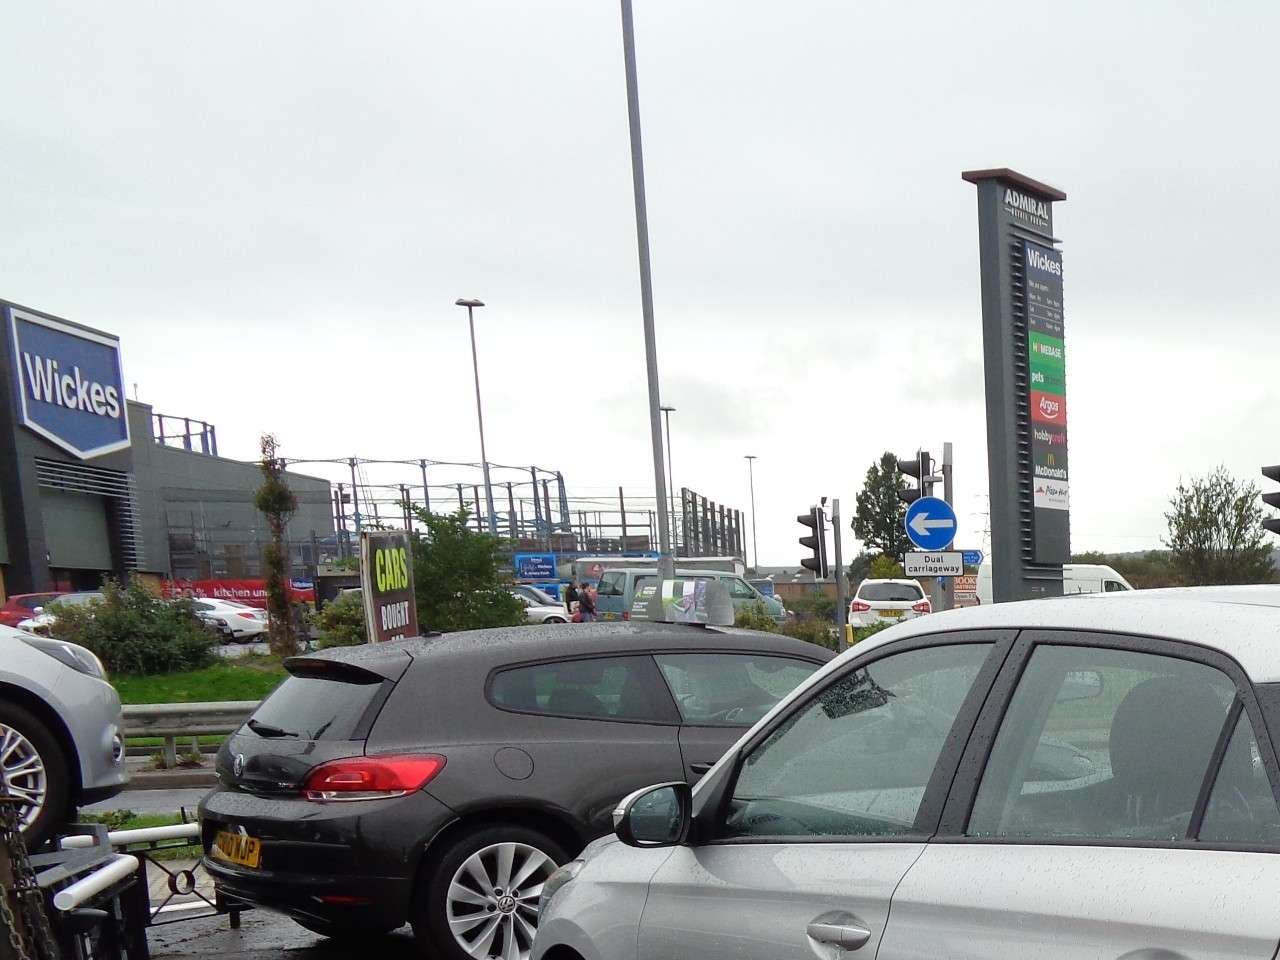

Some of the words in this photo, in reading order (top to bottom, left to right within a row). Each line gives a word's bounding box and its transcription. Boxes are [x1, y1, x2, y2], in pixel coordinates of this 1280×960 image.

[1005, 188, 1048, 219] ADMIRAL
[1027, 248, 1060, 275] Wickes
[1032, 341, 1062, 358] HOMEBASE
[24, 352, 120, 419] Wickes
[1031, 372, 1044, 383] pets
[1040, 396, 1059, 414] Argos
[1035, 464, 1067, 479] McDonald's
[924, 555, 944, 564] Dual
[375, 546, 409, 592] CARS
[908, 564, 960, 575] carriageway
[213, 587, 250, 597] kitchen
[381, 601, 409, 631] BOUGHT
